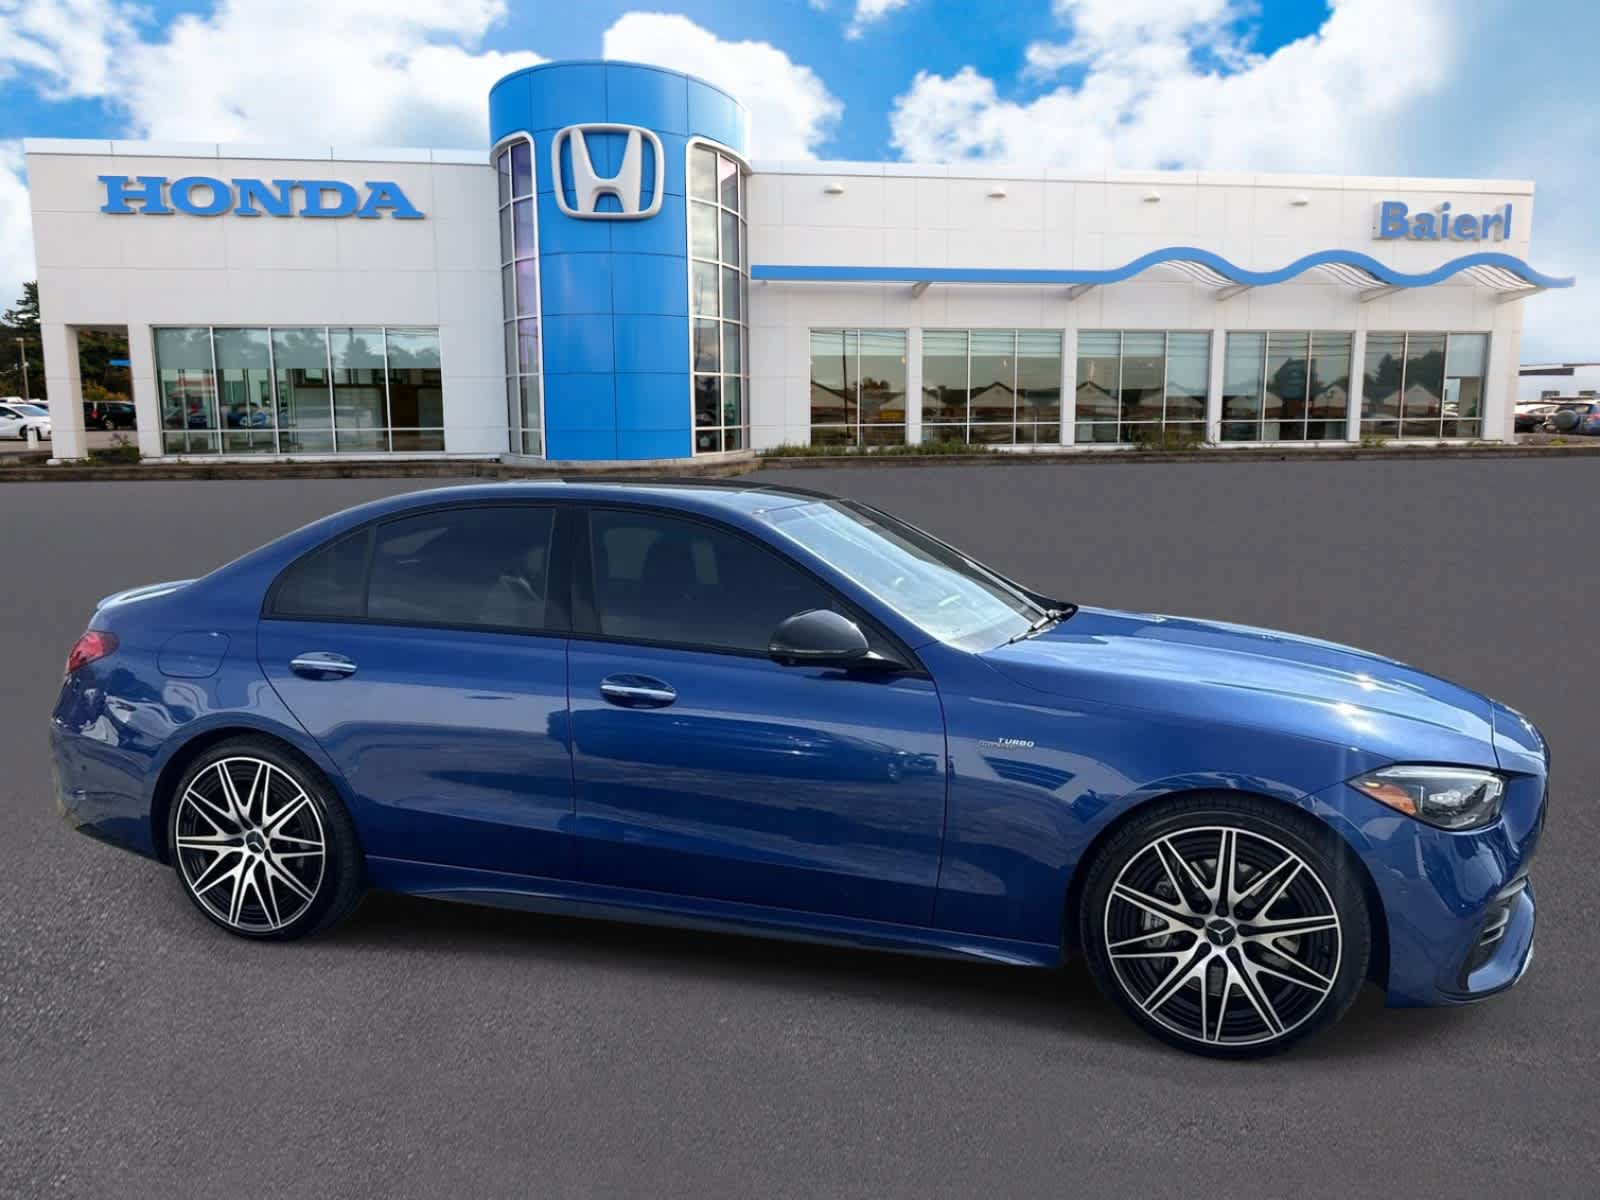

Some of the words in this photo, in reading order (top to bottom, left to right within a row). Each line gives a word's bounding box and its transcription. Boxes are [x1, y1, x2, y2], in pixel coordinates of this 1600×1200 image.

[97, 175, 425, 219] HONDA
[1378, 200, 1513, 240] Baierl
[998, 737, 1035, 748] TURBO
